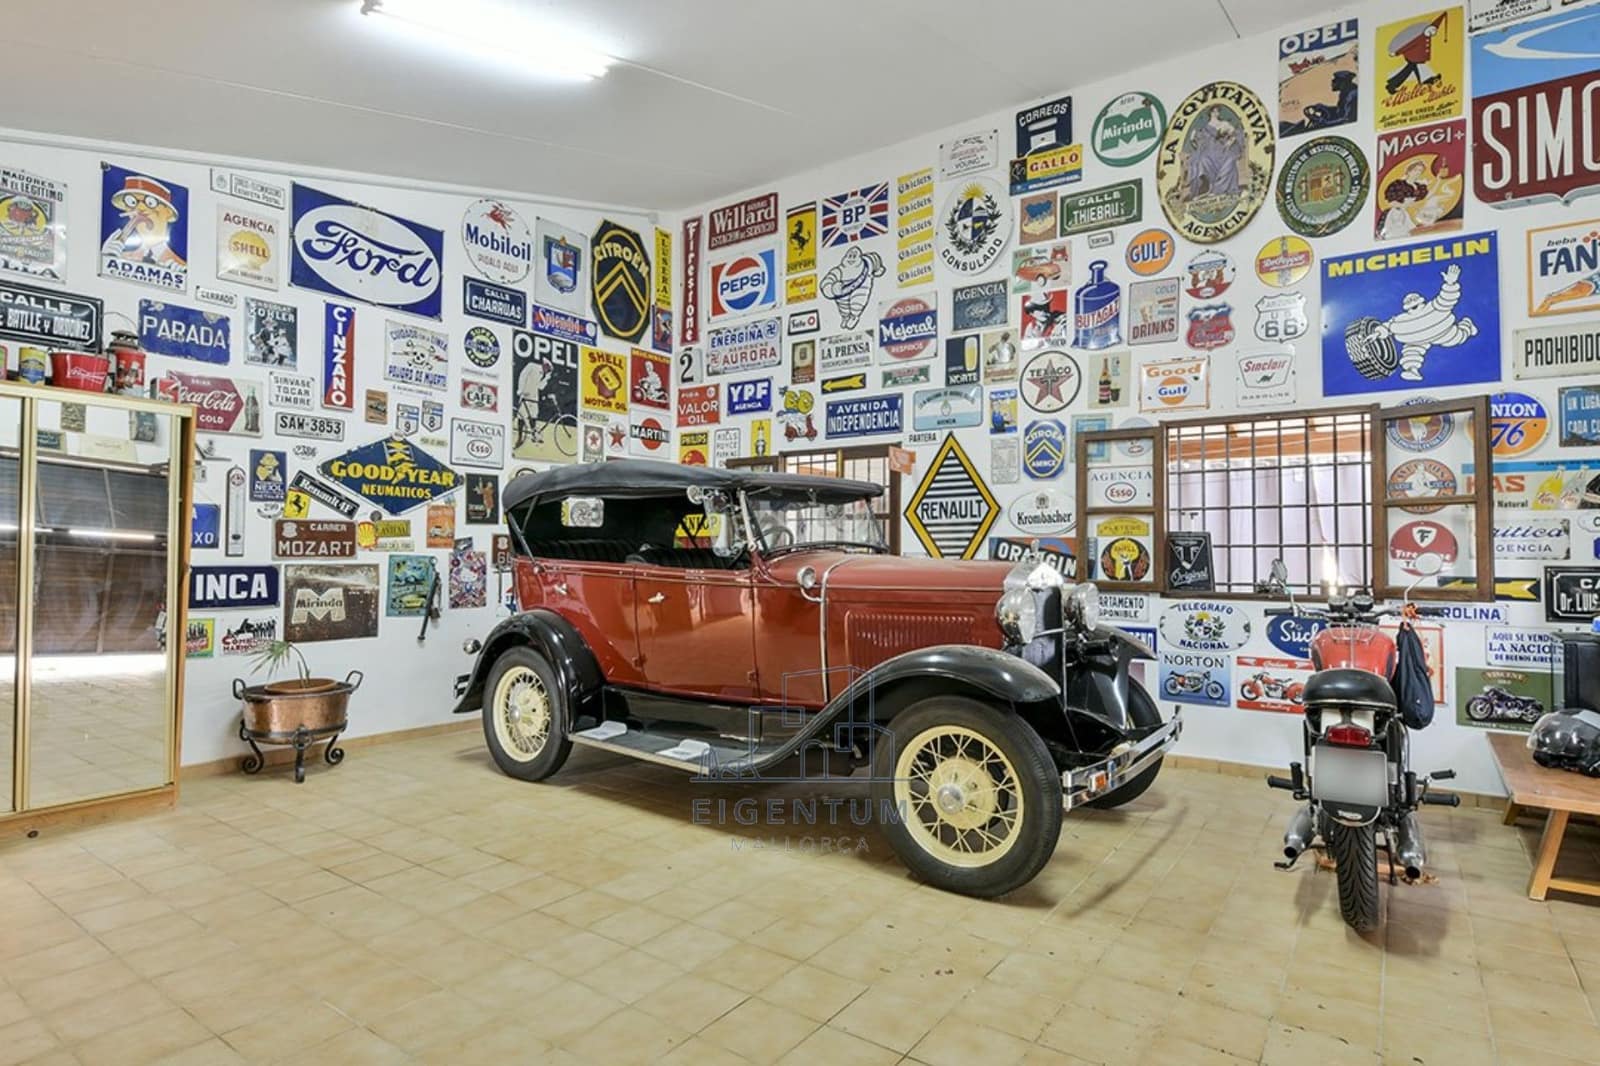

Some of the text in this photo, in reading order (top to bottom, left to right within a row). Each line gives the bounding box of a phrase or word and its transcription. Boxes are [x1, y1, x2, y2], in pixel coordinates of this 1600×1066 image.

[1282, 21, 1356, 54] OPEL
[1018, 103, 1068, 127] CORREOS
[1103, 118, 1153, 140] Mirinda
[1163, 139, 1180, 166] LA
[1379, 128, 1452, 170] MAGGI
[1029, 152, 1079, 173] GALLO
[0, 169, 54, 189] MADORES
[20, 183, 63, 202] LEGITIMO
[1078, 190, 1121, 207] CALLE
[223, 212, 275, 235] AGENCIA
[713, 196, 775, 234] Willard
[842, 205, 866, 226] BP
[1184, 209, 1248, 238] AGENCIA
[232, 240, 268, 259] SHELL
[465, 223, 531, 261] Mobiloil
[1547, 237, 1577, 247] beba
[302, 220, 434, 287] Ford
[942, 238, 1003, 271] CONSULADO
[1130, 240, 1168, 263] GULF
[1328, 238, 1490, 278] MICHELIN
[1540, 239, 1600, 276] FAN
[0, 260, 60, 279] LLA
[107, 259, 184, 284] ADAMAS
[686, 221, 698, 341] Firestone
[720, 272, 765, 295] PEPSI
[1155, 284, 1176, 295] COLD
[201, 291, 234, 305] CERRADO
[484, 288, 510, 301] CALLE
[955, 284, 1005, 302] AGENCIA
[0, 292, 73, 314] CALLE
[472, 295, 522, 320] CHARRUAS
[7, 308, 41, 332] BATLLE
[880, 316, 936, 342] Mejoral
[1132, 318, 1175, 339] DRINKS
[1265, 319, 1298, 338] 66
[143, 315, 227, 349] PARADA
[711, 330, 763, 348] ENERGINA
[331, 307, 347, 406] CINZANO
[514, 333, 577, 369] OPEL
[722, 347, 777, 366] AURORA
[821, 342, 871, 360] LA PRENSA
[588, 352, 624, 370] SHELL
[680, 353, 694, 383] 2
[1244, 359, 1287, 373] Sinclair
[1029, 366, 1072, 377] TEXACO
[1147, 363, 1202, 378] Good
[274, 375, 311, 388] SIRVASE
[277, 385, 310, 396] TOCAR
[1158, 385, 1189, 396] Gulf
[275, 395, 311, 406] TIMBRE
[730, 381, 769, 402] YPF
[584, 397, 627, 411] MOTOR OIL
[679, 400, 719, 415] VALOR
[836, 399, 889, 414] AVENIDA
[1491, 403, 1538, 417] NION
[200, 414, 224, 424] COLD
[404, 421, 411, 432] 9
[429, 416, 435, 427] 8
[688, 414, 707, 424] OIL
[828, 410, 900, 433] INDEPENDENCIA
[456, 423, 502, 436] AGENCIA
[908, 433, 937, 442] PARTERA
[1491, 420, 1526, 448] 76
[470, 441, 490, 455] Esso
[1091, 471, 1152, 482] AGENCIA
[301, 478, 338, 506] Renault
[362, 483, 432, 500] NEUMATICOS
[1110, 488, 1133, 498] Esso
[921, 500, 983, 520] RENAULT
[1497, 500, 1528, 508] Natural
[1017, 510, 1073, 526] Krombacher
[310, 523, 347, 532] CARRER
[278, 540, 353, 556] MOZART
[1496, 544, 1552, 552] GENCIA
[998, 542, 1077, 577] ORAGIN
[195, 573, 268, 600] INCA
[296, 598, 343, 609] Mirinda
[1177, 601, 1234, 615] TELEGRAFO
[1441, 607, 1501, 620] ROLINA
[1179, 640, 1229, 650] NACIONAL
[1492, 632, 1512, 641] AQUI
[1516, 633, 1524, 641] SE
[1489, 643, 1506, 652] LA
[1164, 655, 1225, 669] NORTON
